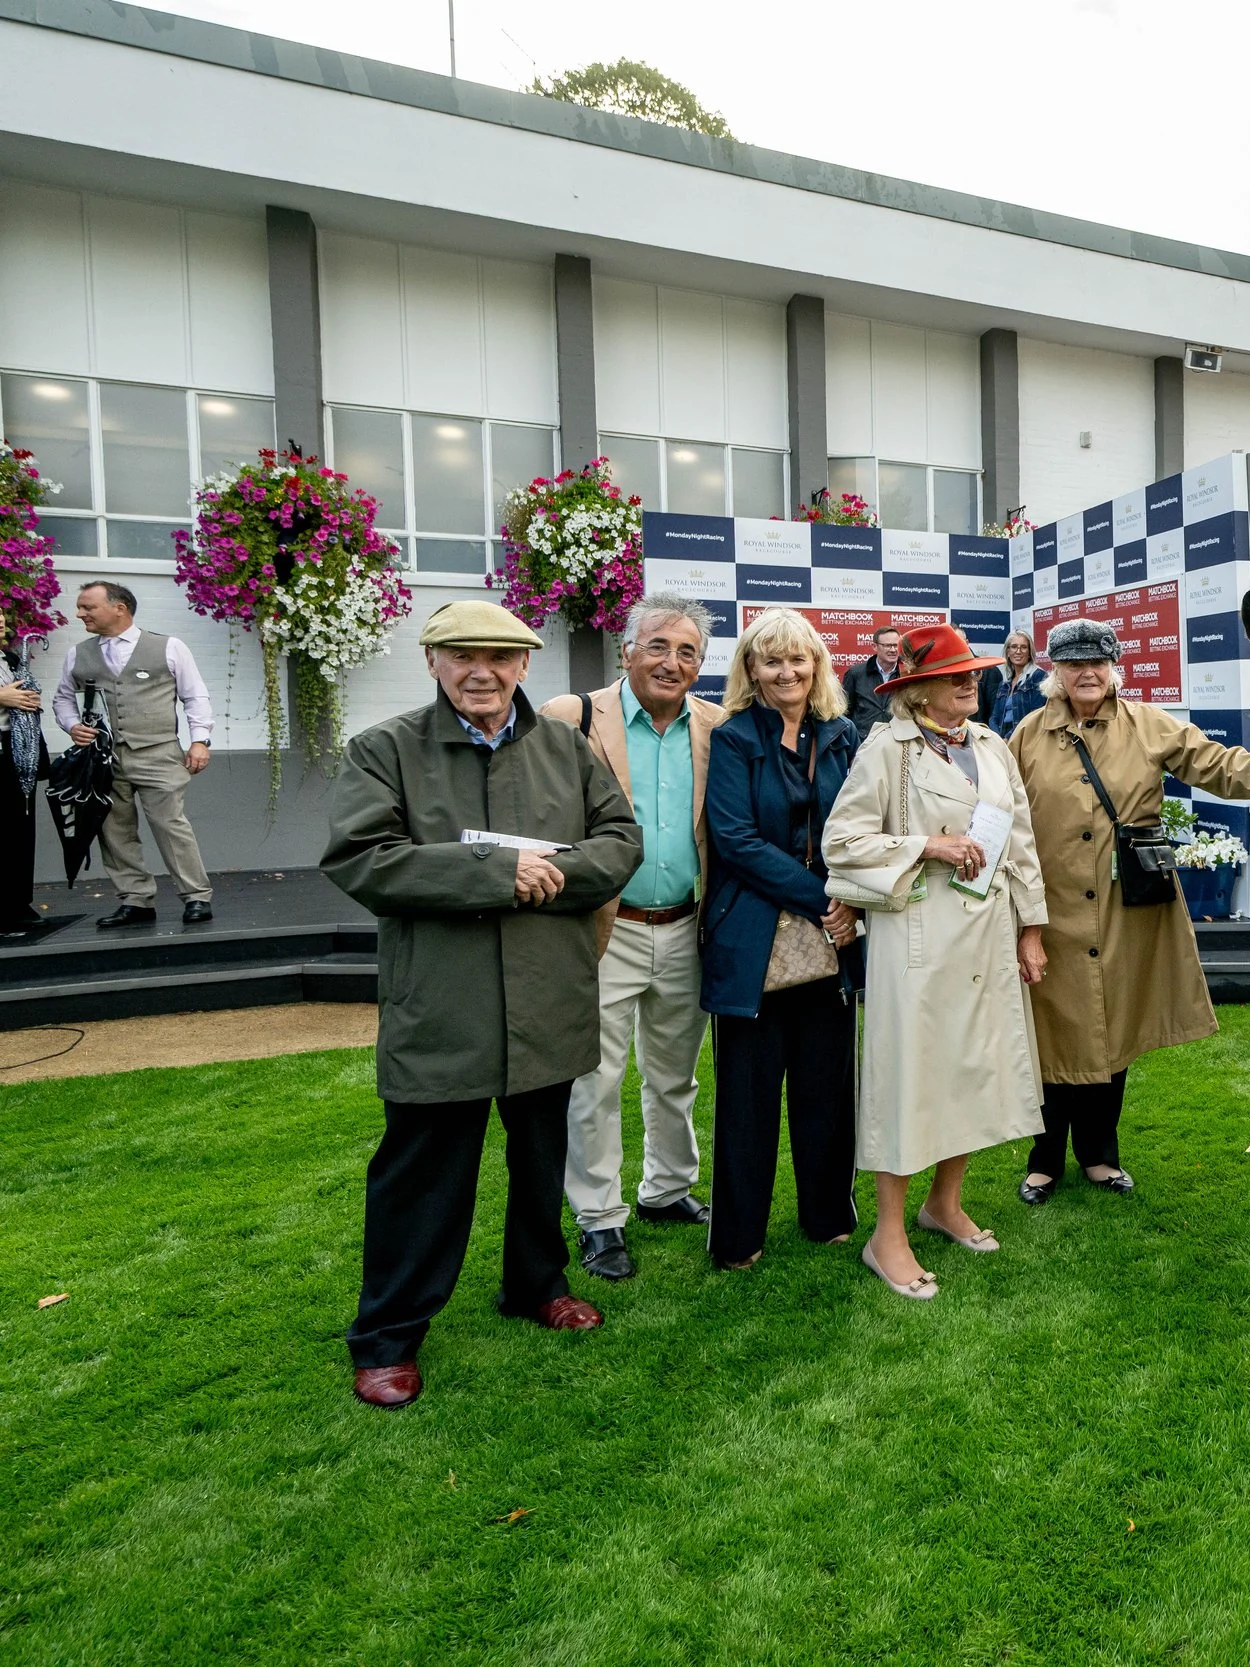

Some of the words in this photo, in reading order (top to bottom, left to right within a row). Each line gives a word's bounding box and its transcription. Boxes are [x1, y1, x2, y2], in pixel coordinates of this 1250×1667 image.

[665, 532, 725, 542] #MondayNightRacing
[743, 540, 767, 548] ROYAL
[767, 541, 801, 550] WINDSOR
[820, 542, 873, 551] #MondayNightRacing
[910, 551, 941, 559] WINDSOR
[958, 551, 1004, 560] #MondayNightRacing
[691, 580, 727, 588] WINDSOR
[746, 579, 802, 588] #MondayNightRacing
[843, 587, 875, 595] WINDSOR
[891, 586, 941, 594] #MondayNightRacing
[1148, 583, 1177, 595] MATCHBOOK
[976, 593, 1005, 601] WINDSOR
[821, 612, 874, 621] MATCHBOOK
[891, 614, 940, 623] MATCHBOOK
[959, 623, 1005, 631] #MondayNightRacing
[1149, 635, 1178, 646] MATCHBOOK
